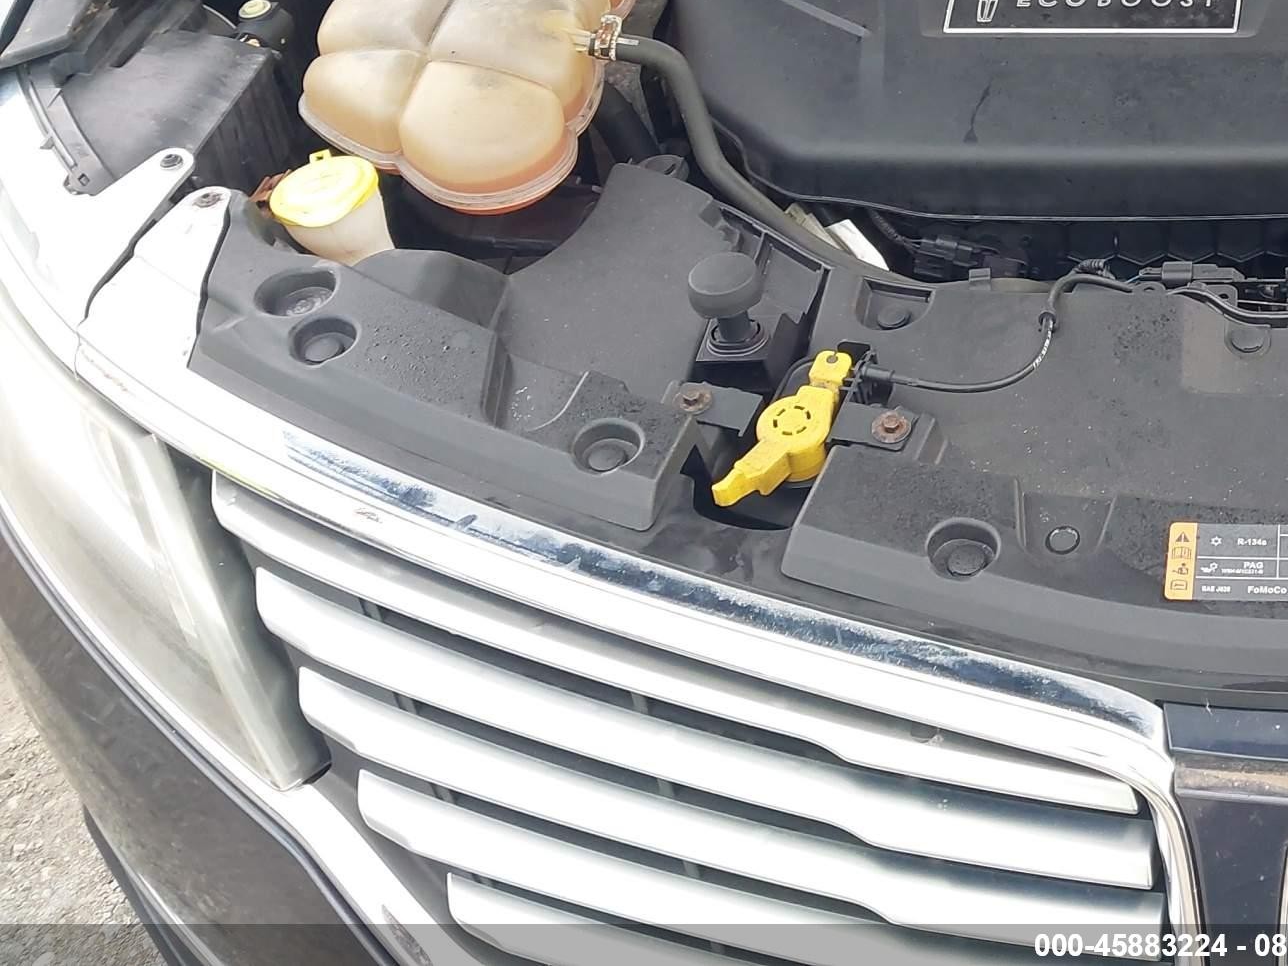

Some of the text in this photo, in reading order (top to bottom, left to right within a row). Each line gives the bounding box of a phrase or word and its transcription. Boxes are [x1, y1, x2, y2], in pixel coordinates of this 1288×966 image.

[1237, 537, 1267, 546] R-134a
[1243, 561, 1264, 569] PAG
[1247, 585, 1288, 595] FoMoCo
